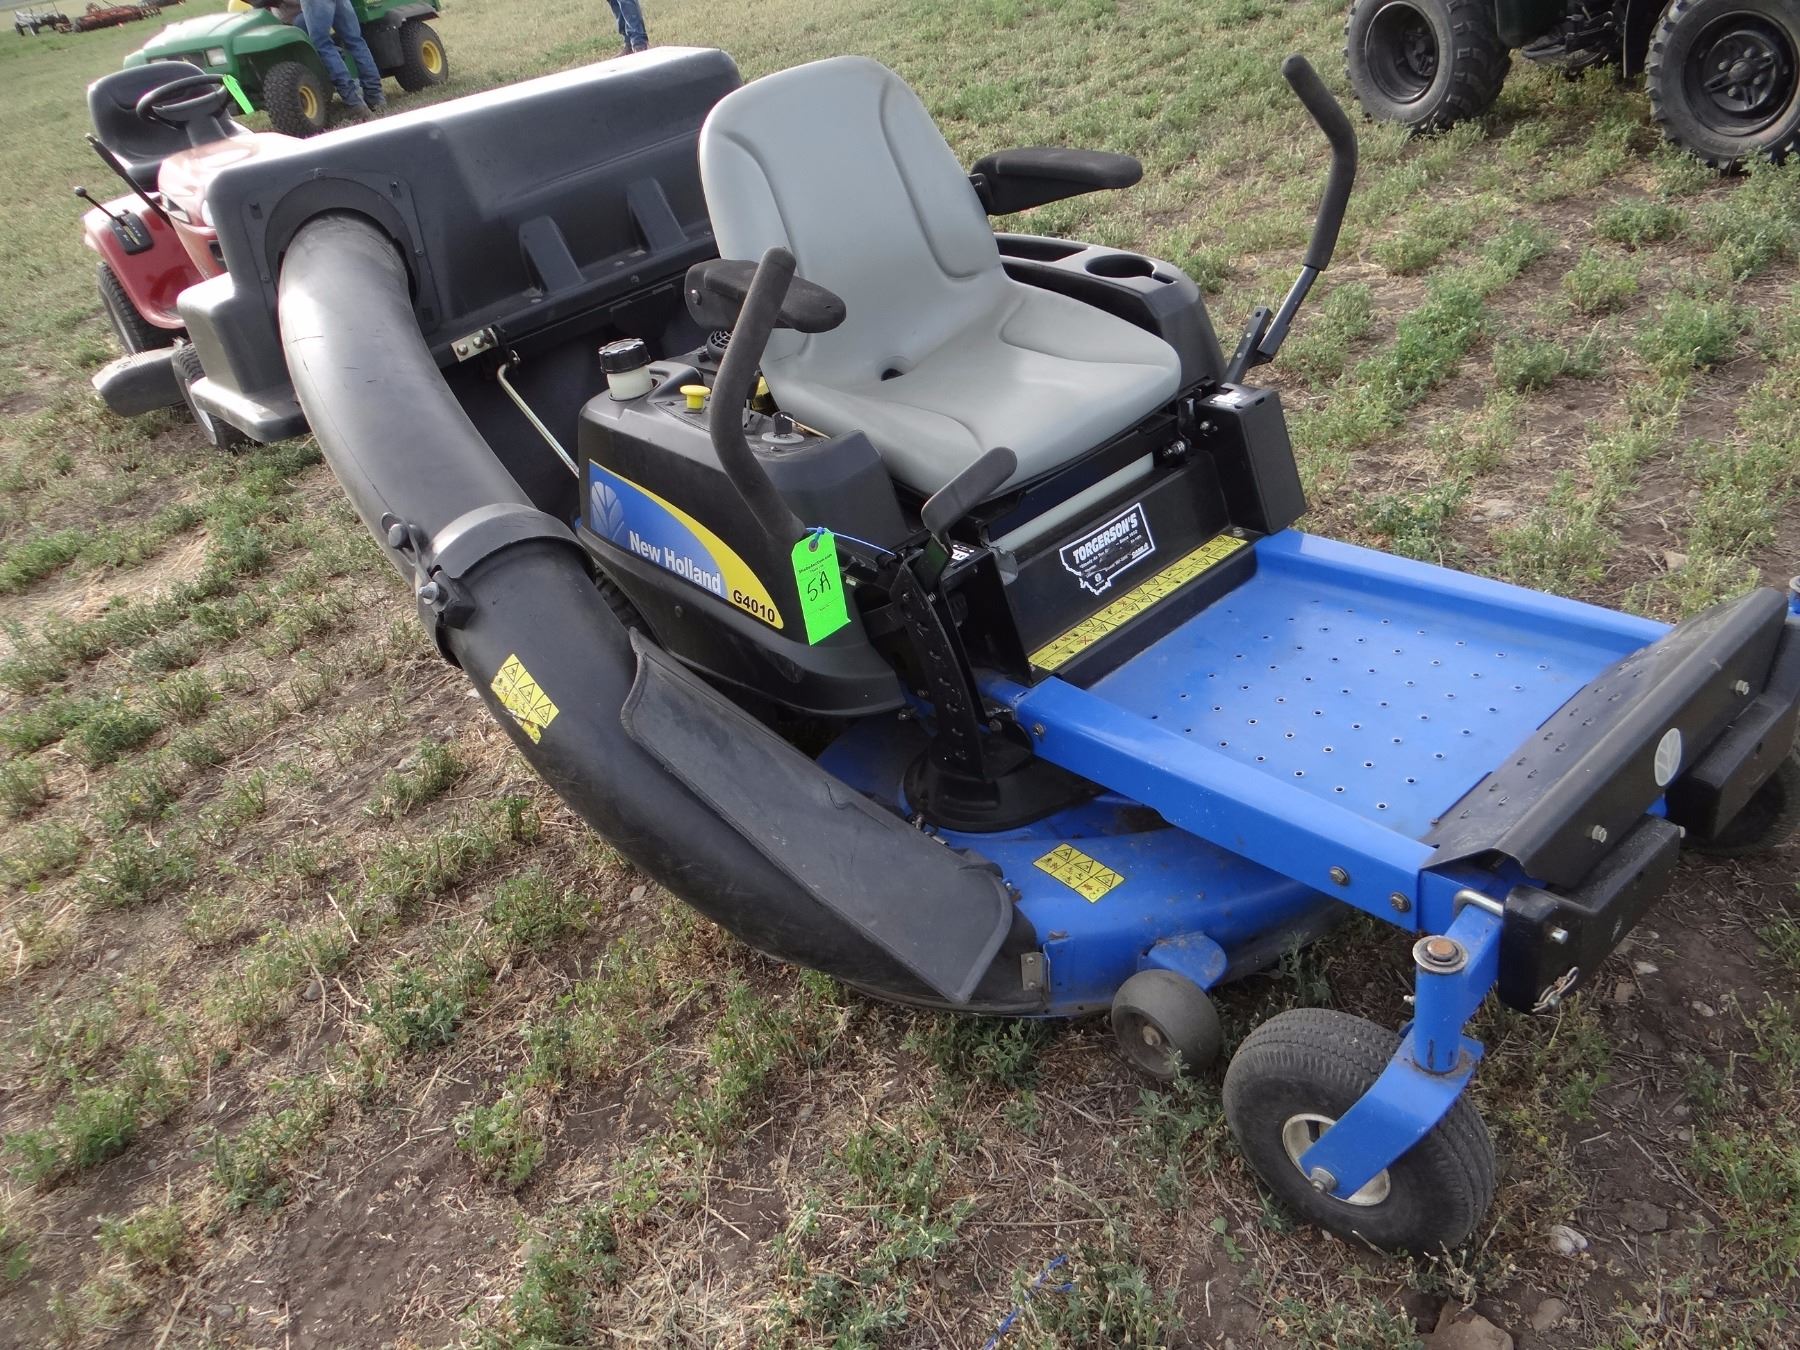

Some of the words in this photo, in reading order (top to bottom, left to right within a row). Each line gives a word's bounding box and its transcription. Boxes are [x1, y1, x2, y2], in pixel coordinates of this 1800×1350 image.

[1072, 512, 1138, 565] TORGERSON'S
[629, 530, 661, 563] New
[664, 547, 721, 594] Holland
[733, 590, 775, 623] G4010
[807, 570, 831, 602] 5A
